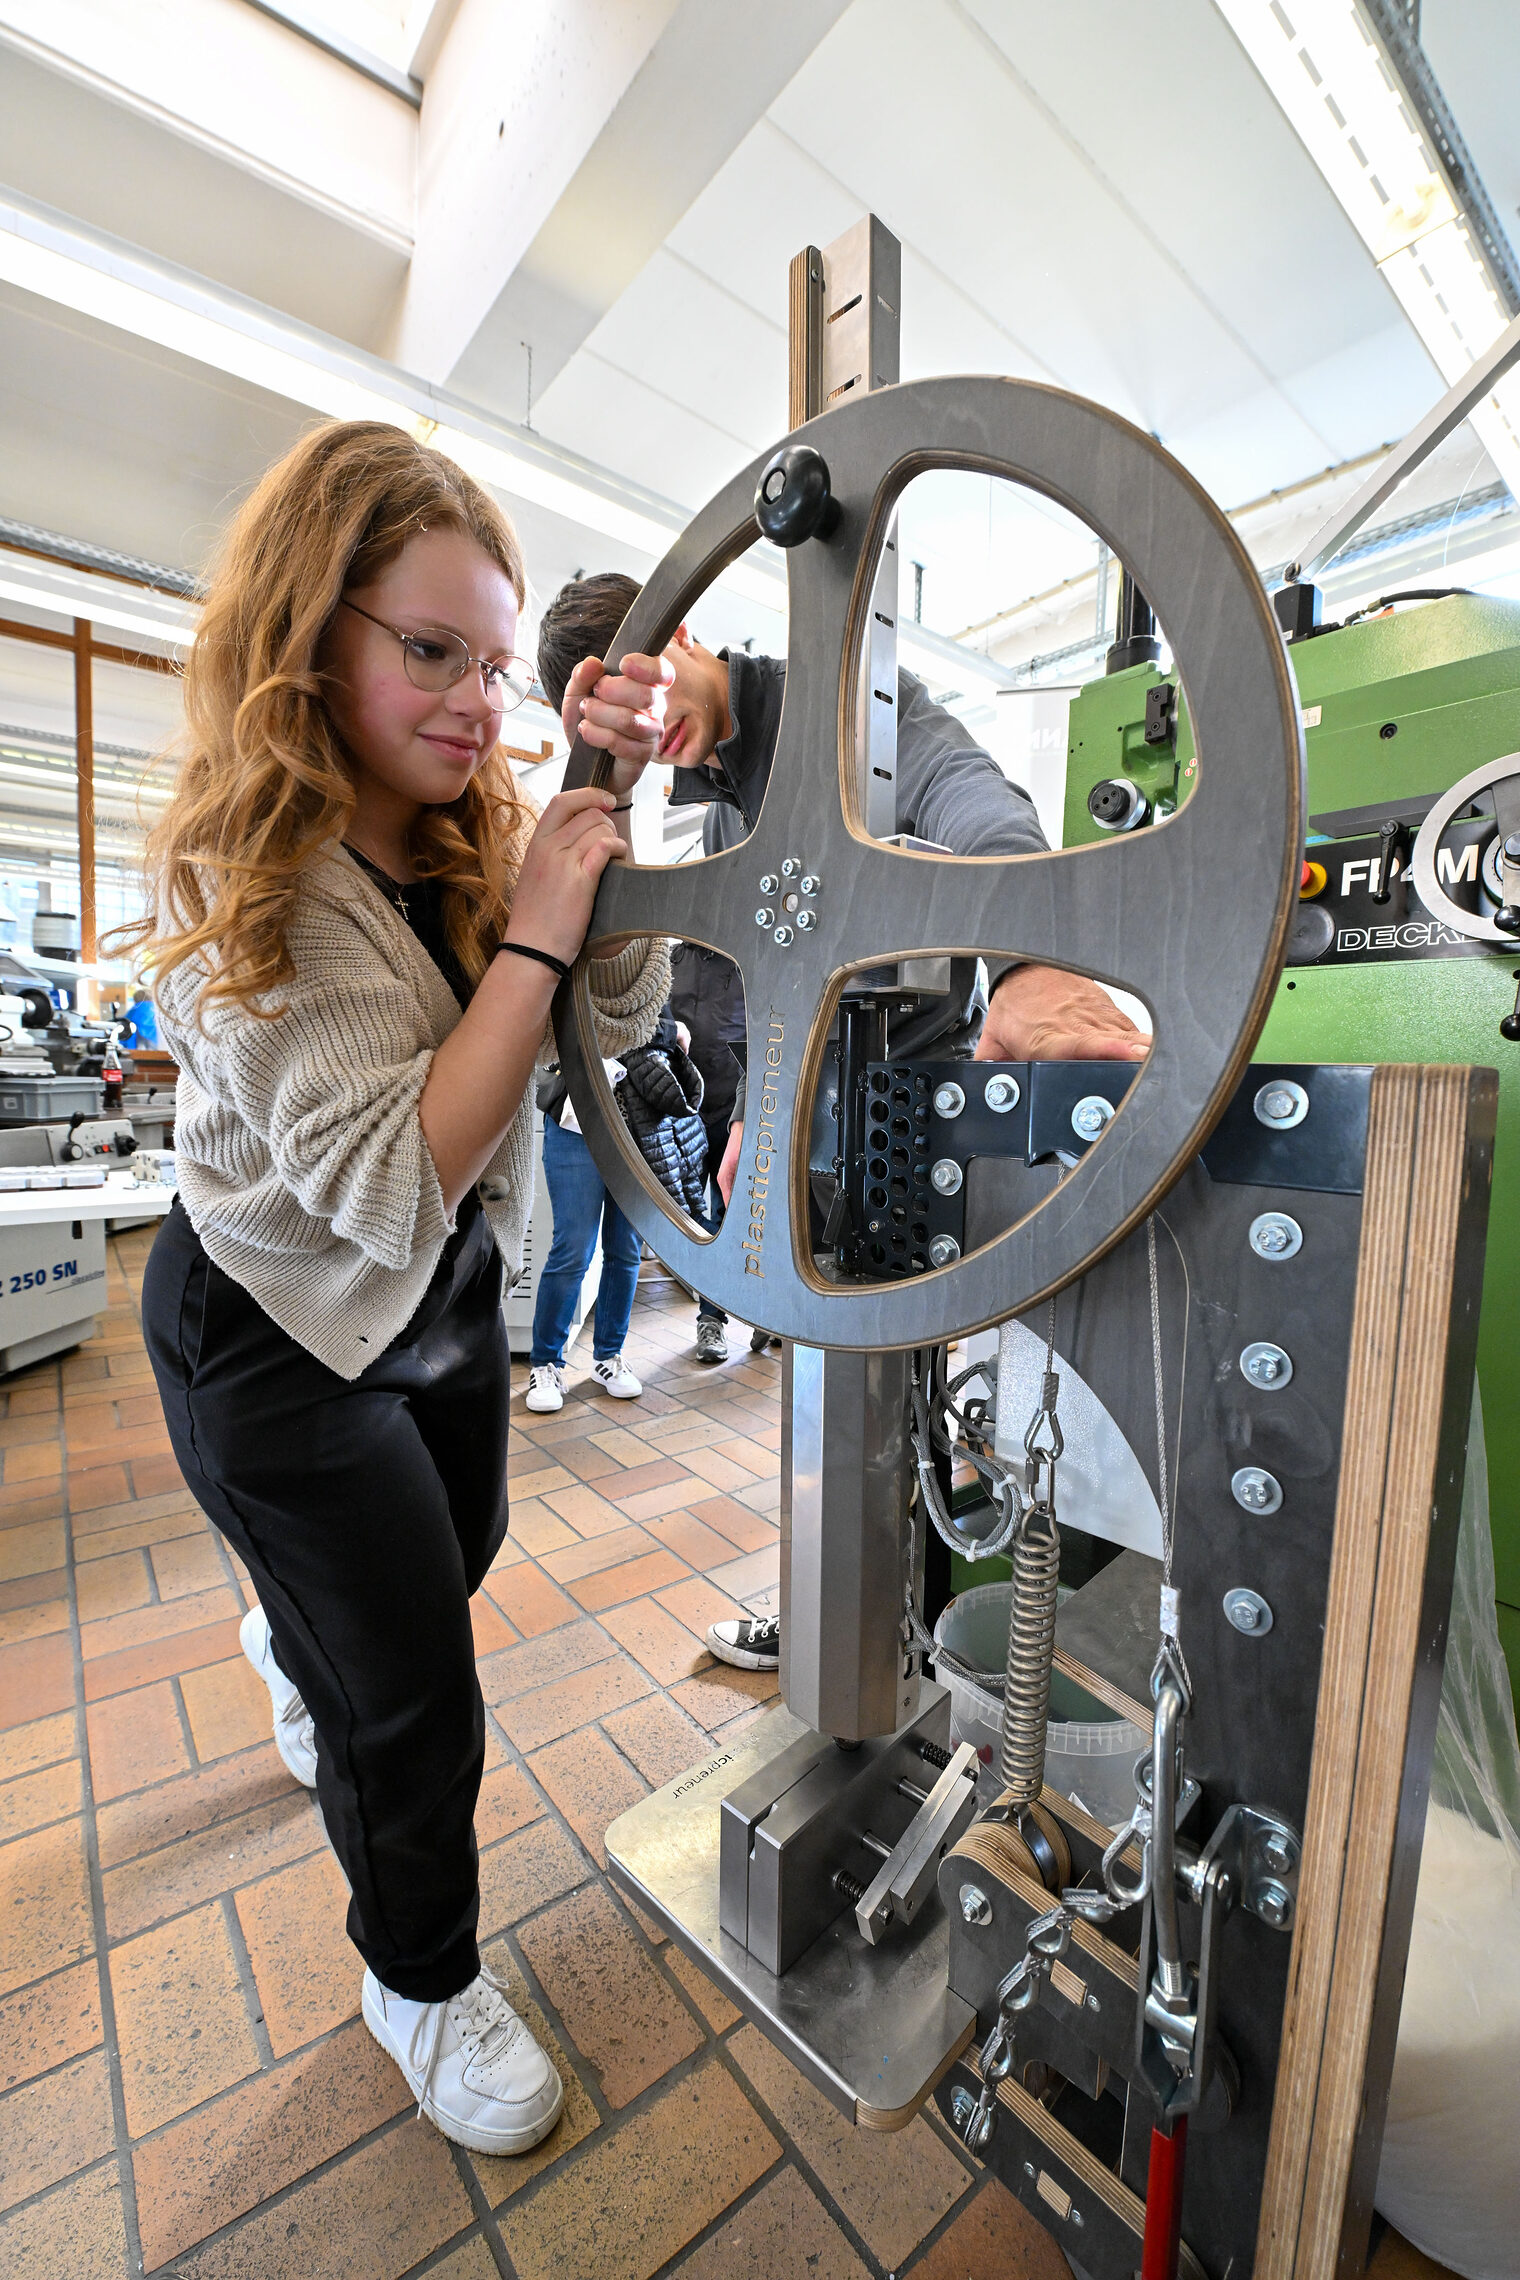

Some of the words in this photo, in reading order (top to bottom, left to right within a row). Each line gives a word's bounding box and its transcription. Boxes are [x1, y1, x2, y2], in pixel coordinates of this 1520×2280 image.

[1337, 921, 1482, 952] DECK
[741, 1004, 786, 1280] plasticpreneur
[9, 1268, 47, 1294] 250
[52, 1259, 78, 1281] SN
